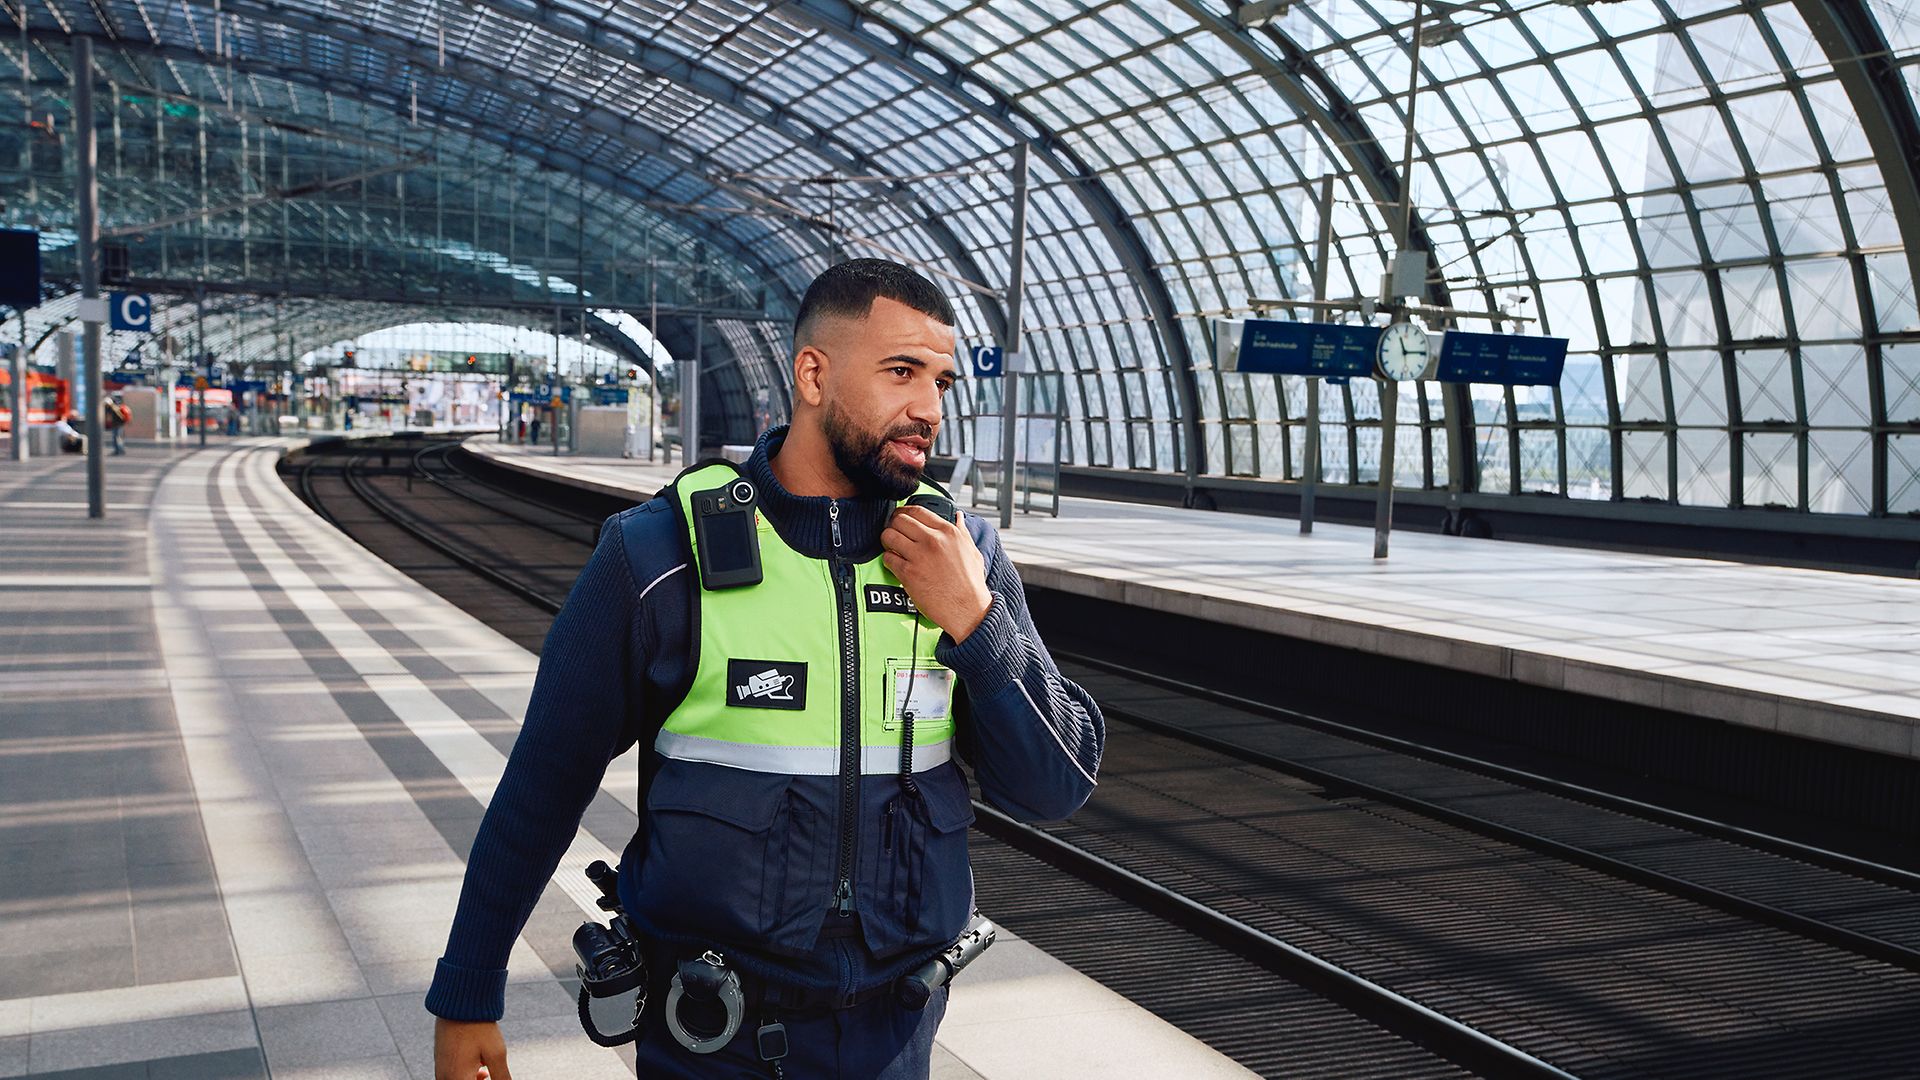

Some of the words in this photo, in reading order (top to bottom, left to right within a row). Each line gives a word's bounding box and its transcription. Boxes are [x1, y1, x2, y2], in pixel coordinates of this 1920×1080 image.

[121, 295, 147, 326] C
[977, 347, 994, 371] C
[870, 590, 892, 604] DB
[894, 593, 914, 607] Sic
